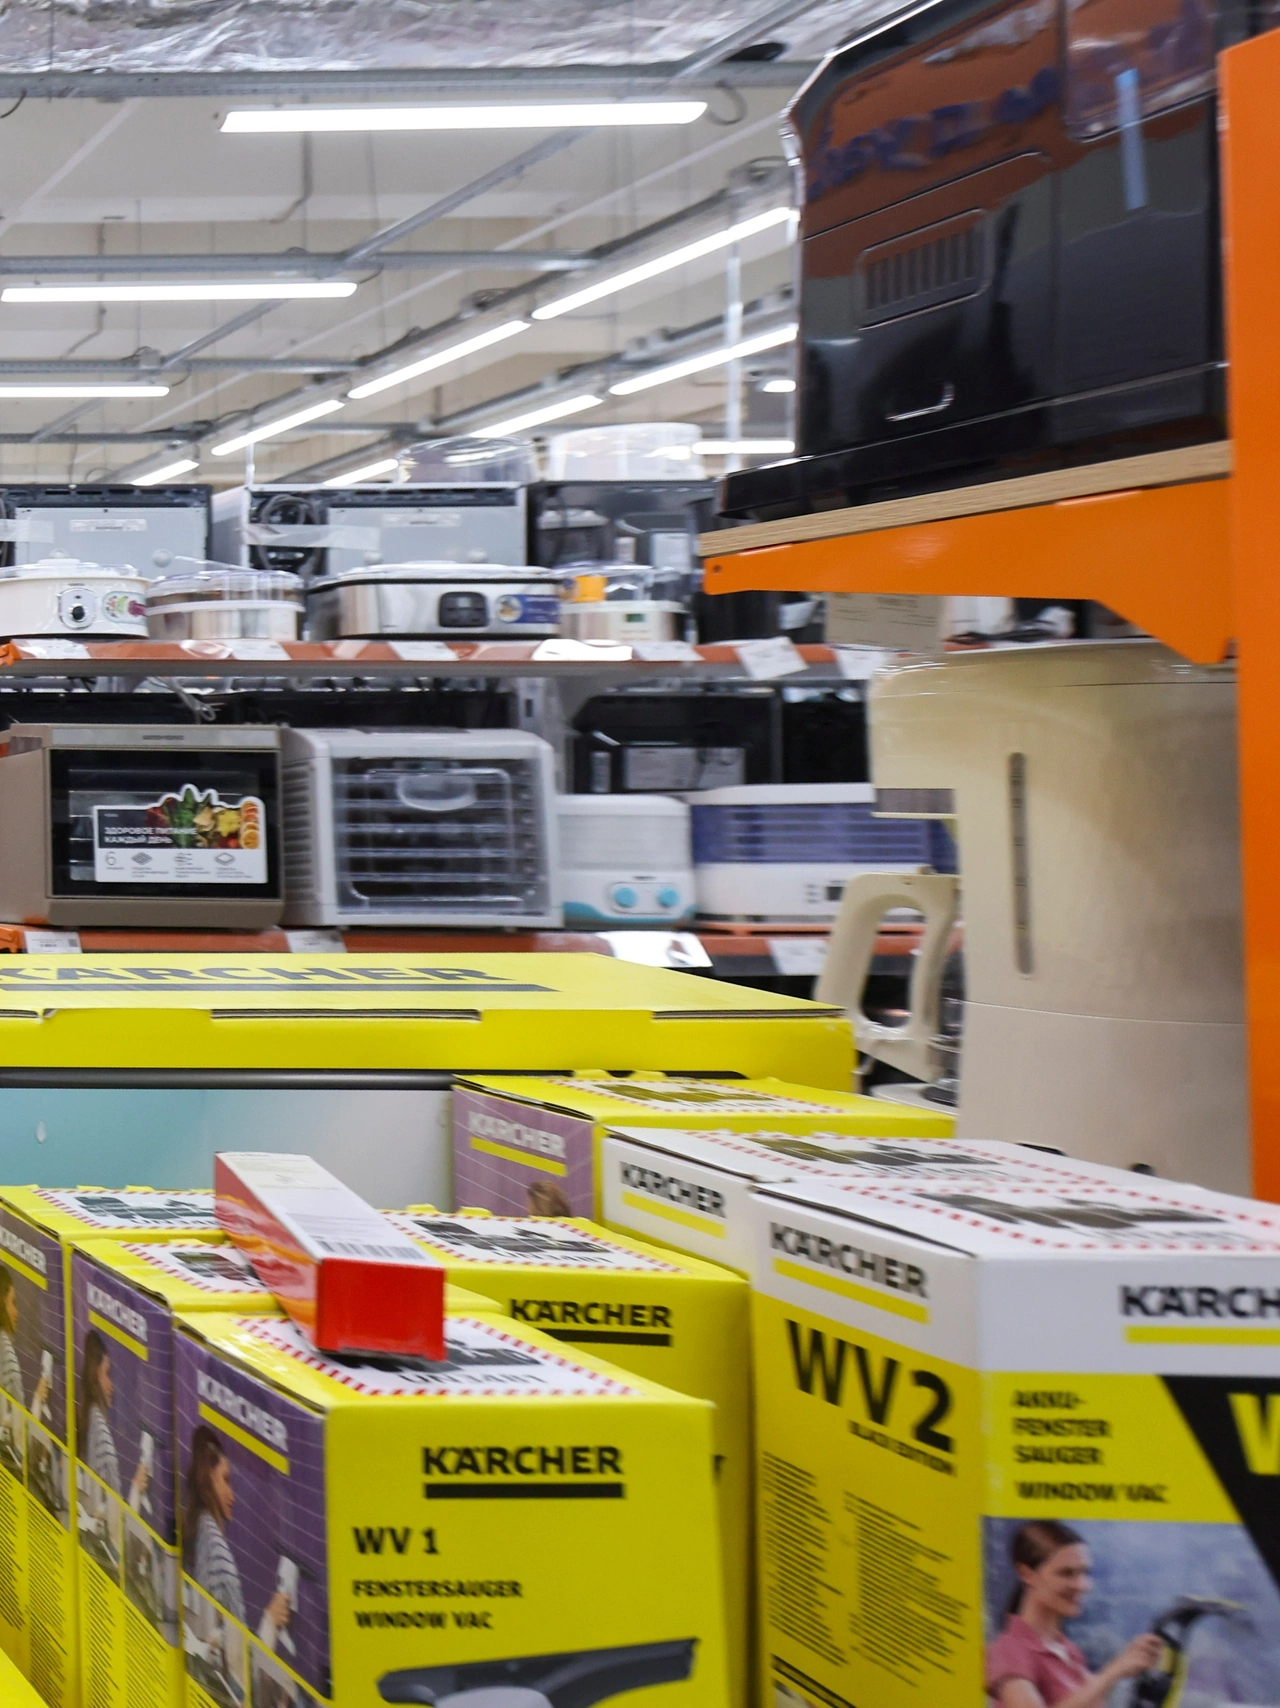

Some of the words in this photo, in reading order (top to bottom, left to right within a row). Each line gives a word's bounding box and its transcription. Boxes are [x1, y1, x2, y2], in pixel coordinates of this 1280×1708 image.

[1119, 1284, 1280, 1319] KÄRCH
[784, 1317, 958, 1455] WV2
[1013, 1417, 1113, 1439] FENSTER
[1013, 1444, 1104, 1467] SAUGER
[1014, 1480, 1118, 1502] WINDOW
[1122, 1482, 1170, 1504] VAC
[351, 1525, 413, 1556] WV
[420, 1525, 440, 1556] 1
[351, 1579, 524, 1598] FENSTERSAUGER
[353, 1610, 447, 1631] WINDOW
[451, 1610, 494, 1631] VAC
